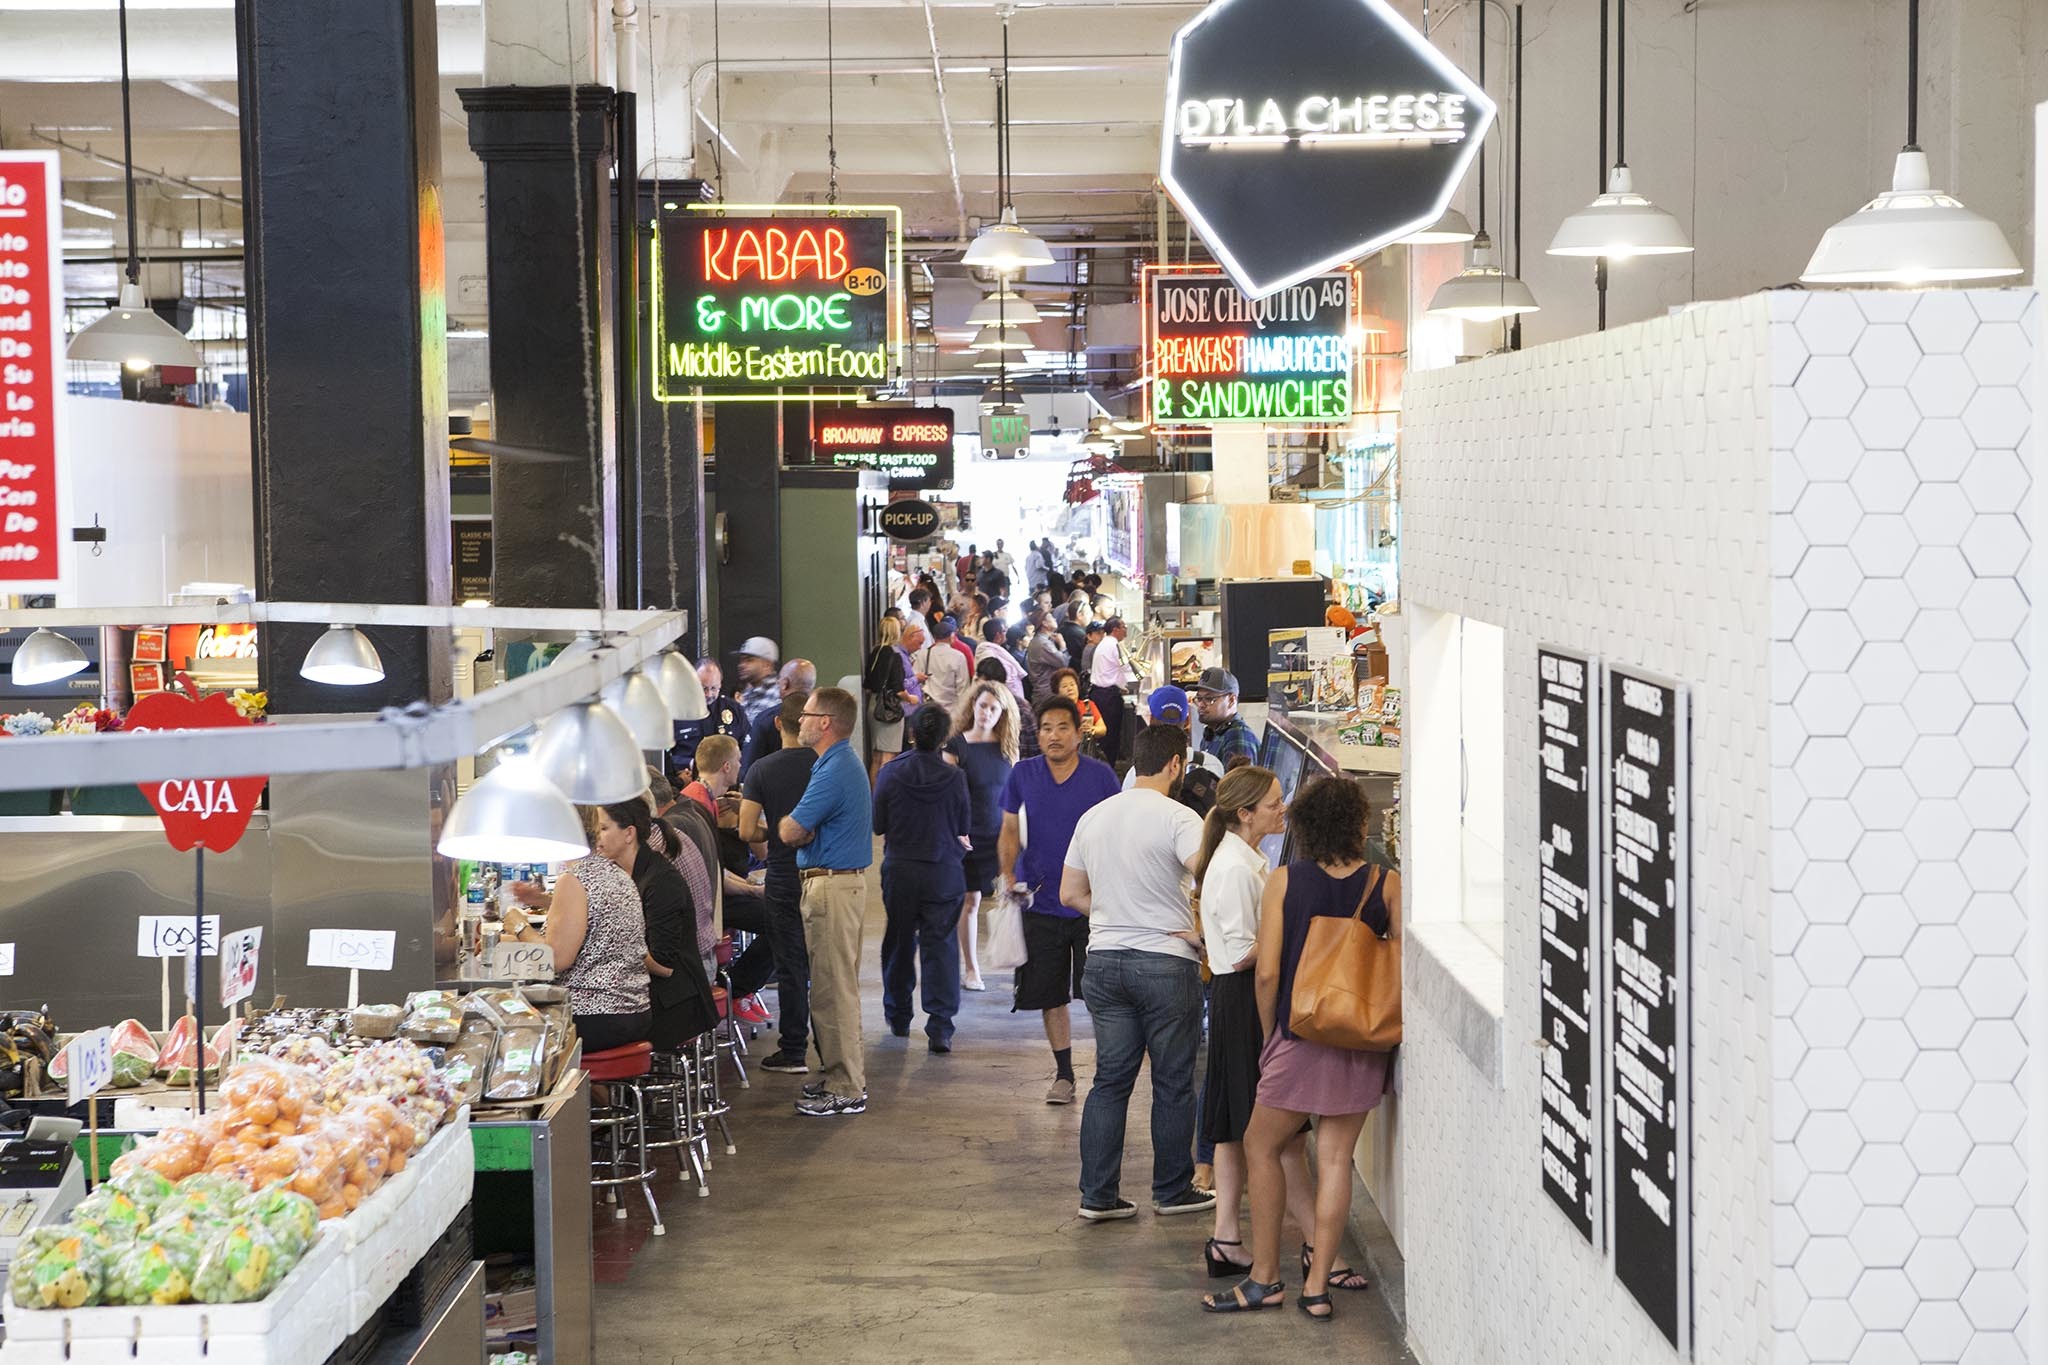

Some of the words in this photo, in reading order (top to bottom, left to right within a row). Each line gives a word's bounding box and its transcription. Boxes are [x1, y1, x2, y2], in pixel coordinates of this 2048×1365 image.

[1180, 98, 1288, 134] DTLA
[1297, 93, 1466, 132] CHEESE
[703, 228, 848, 281] KABAB
[848, 275, 882, 290] B-10
[1319, 281, 1345, 307] A6
[696, 295, 726, 332] &
[740, 293, 852, 331] MORE
[1161, 287, 1211, 323] JOSE
[1214, 286, 1317, 329] CHIQUITO
[669, 342, 742, 377] Middle
[745, 345, 825, 381] Eastern
[827, 343, 885, 379] Food
[1155, 336, 1244, 374] BREAKFAST
[1243, 336, 1348, 374] HAMBURGERS
[4, 364, 34, 384] Su
[1155, 378, 1173, 416] &
[1181, 379, 1349, 418] SANDWICHES
[822, 426, 884, 444] BROADWAY
[892, 424, 948, 442] EXPRESS
[991, 417, 1024, 443] EXIT
[879, 454, 904, 465] FAST
[903, 454, 938, 465] FOOD
[5, 512, 38, 532] De
[885, 513, 934, 525] PICK-UP
[158, 778, 239, 820] CAJA
[154, 919, 197, 956] 100
